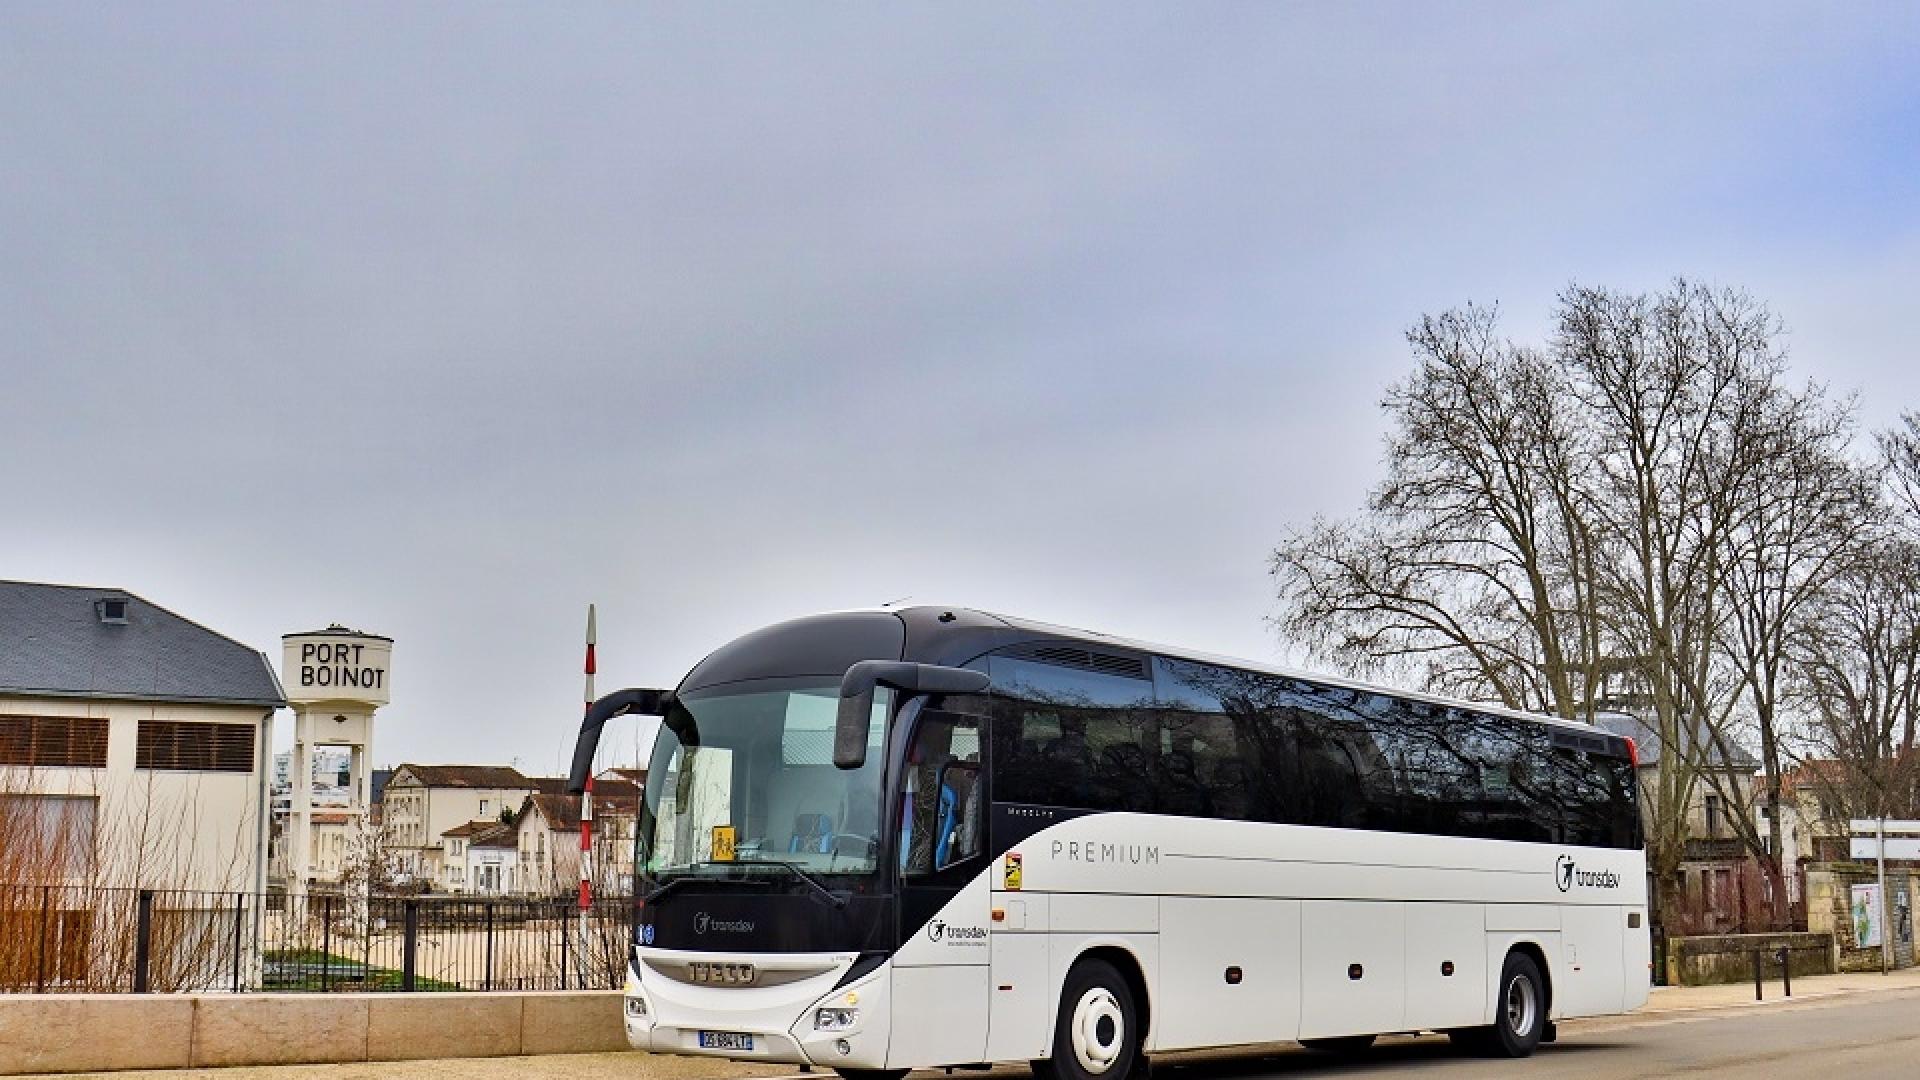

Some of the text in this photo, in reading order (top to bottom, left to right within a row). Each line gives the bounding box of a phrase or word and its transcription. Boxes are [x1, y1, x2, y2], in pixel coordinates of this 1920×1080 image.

[302, 644, 364, 664] PORT
[302, 666, 384, 688] BOINOT
[1051, 840, 1159, 864] PREMIUM
[1575, 868, 1620, 888] transdev
[711, 919, 755, 933] transdev
[947, 925, 988, 939] transdev
